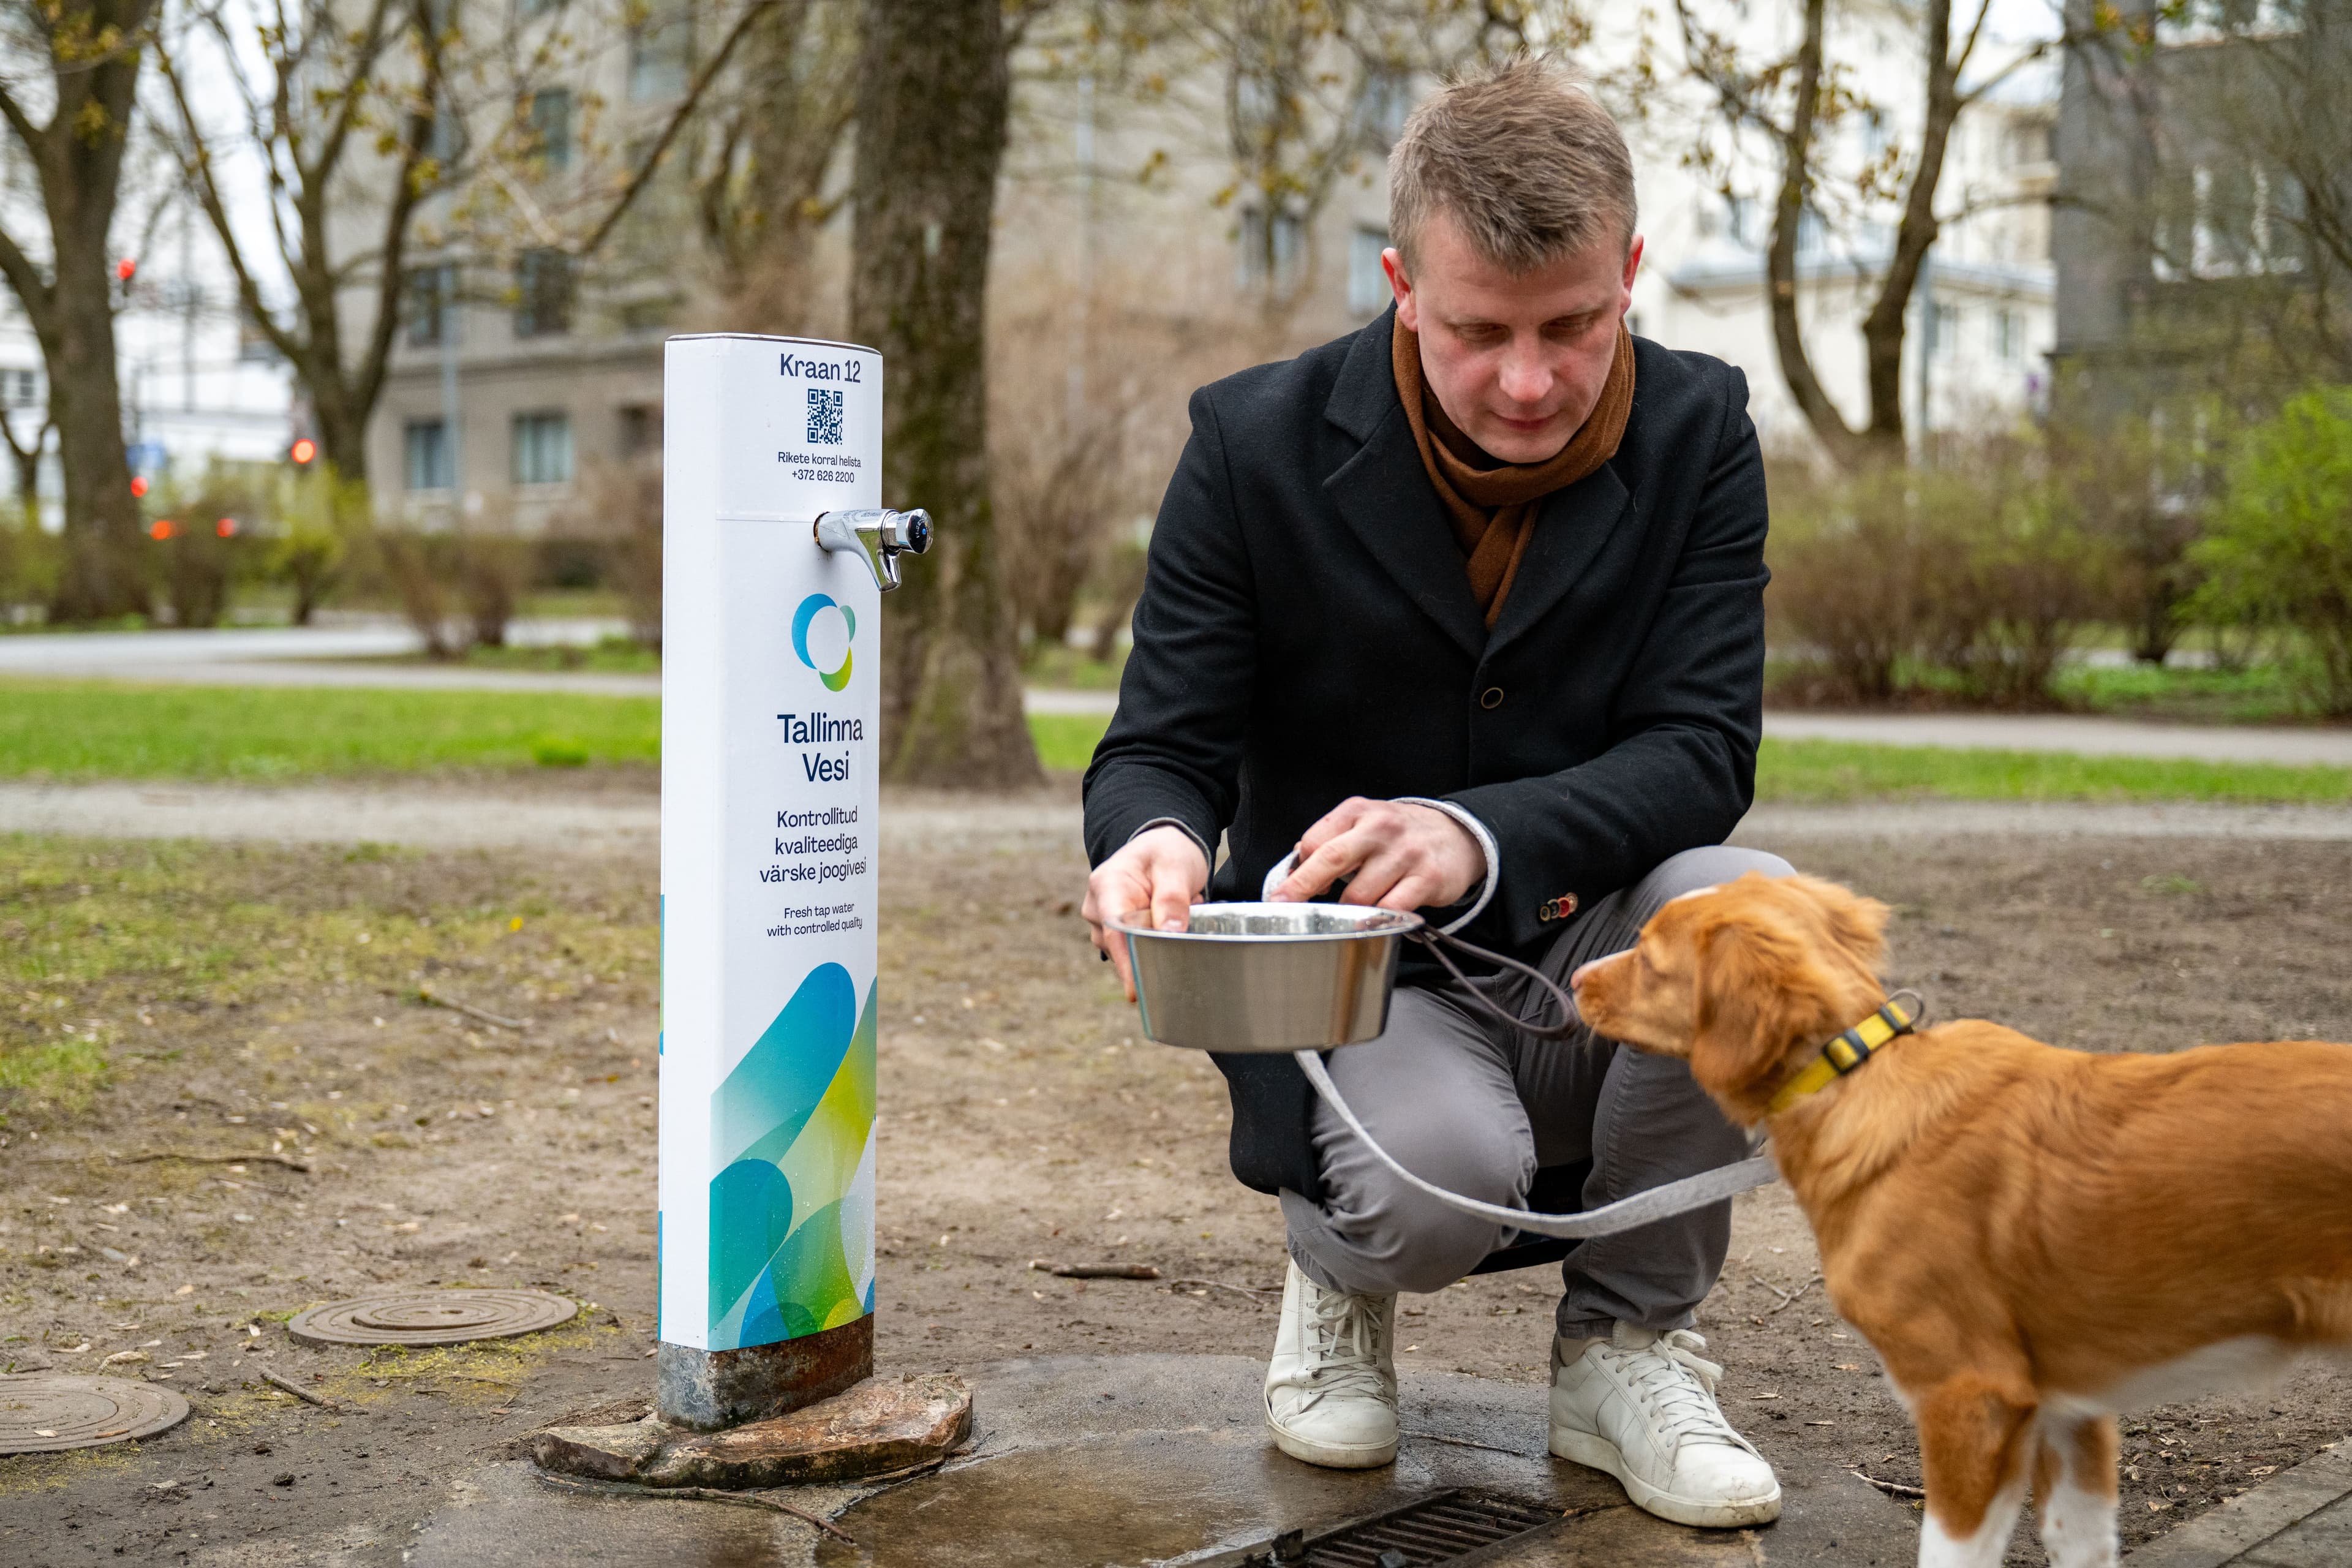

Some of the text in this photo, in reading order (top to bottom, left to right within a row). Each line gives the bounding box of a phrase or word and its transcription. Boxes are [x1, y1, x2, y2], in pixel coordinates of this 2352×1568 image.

[780, 353, 861, 383] Kraan 12
[778, 451, 861, 468] Rikete korral helista
[792, 469, 854, 483] +372 626 2200
[777, 712, 863, 744] Tallinna
[802, 750, 849, 782] Vesi
[777, 805, 858, 828] Kontrollitud
[775, 832, 858, 855] kvaliteediga
[760, 856, 866, 884] värske joogivesi
[784, 902, 854, 919] Fresh tap water
[767, 916, 862, 937] with controlled quality
